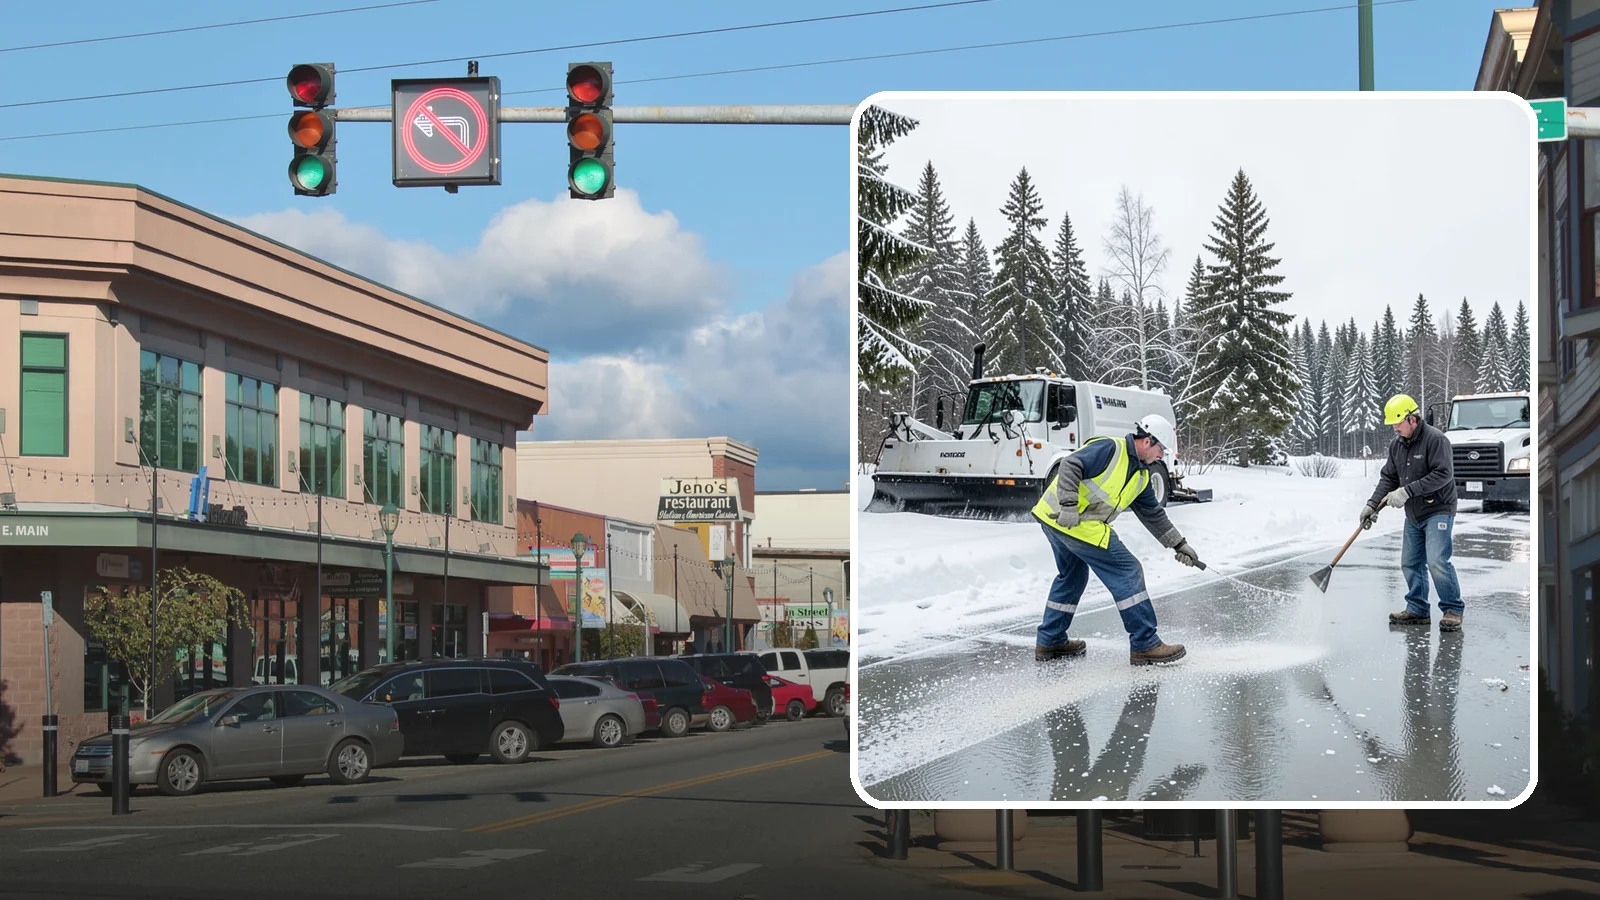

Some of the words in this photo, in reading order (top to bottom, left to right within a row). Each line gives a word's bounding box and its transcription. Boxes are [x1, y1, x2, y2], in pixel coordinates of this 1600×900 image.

[670, 480, 727, 494] Jeno's
[665, 496, 731, 509] restaurant
[658, 510, 682, 519] Italian
[686, 509, 714, 519] American
[715, 509, 738, 519] Cuisine
[2, 525, 13, 536] E.
[15, 525, 49, 536] MAIN
[797, 607, 828, 616] Street
[791, 619, 823, 627] lass
